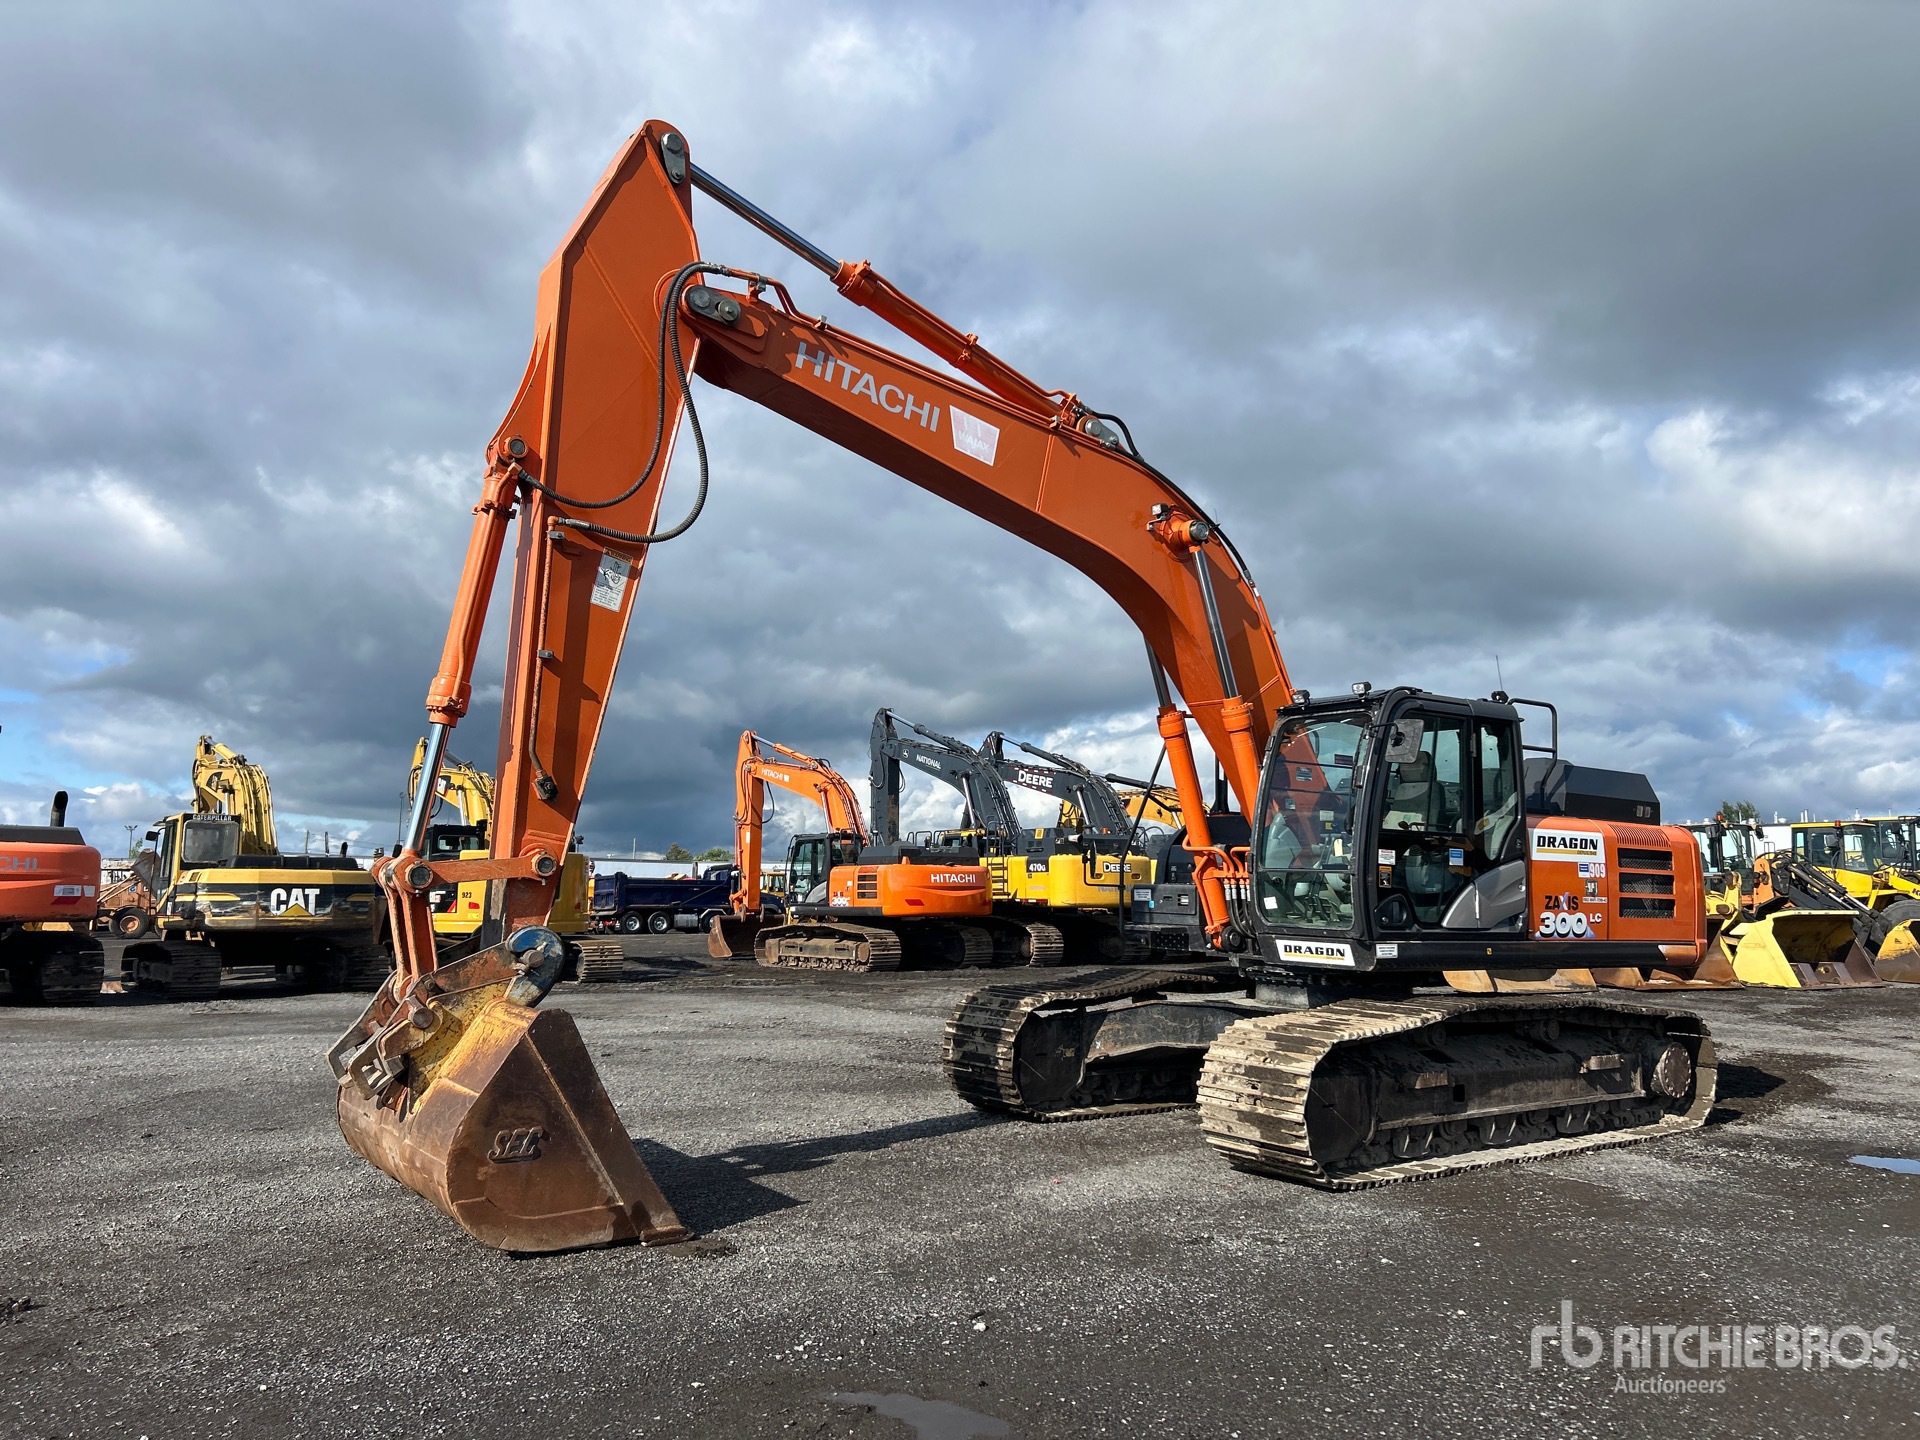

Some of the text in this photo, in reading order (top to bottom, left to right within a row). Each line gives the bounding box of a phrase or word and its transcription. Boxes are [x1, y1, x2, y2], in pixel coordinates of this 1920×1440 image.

[795, 342, 941, 432] HITACHI
[916, 754, 942, 769] NATIONAL
[761, 768, 783, 781] HITACHI
[1018, 769, 1053, 788] DEERE
[1537, 835, 1598, 850] DRAGON
[931, 873, 976, 883] HITACHI
[1590, 863, 1606, 878] 909
[270, 888, 320, 917] CAT
[1545, 892, 1579, 911] ZAXIS
[1539, 912, 1602, 938] 300 LC
[1284, 944, 1345, 957] DRAGON
